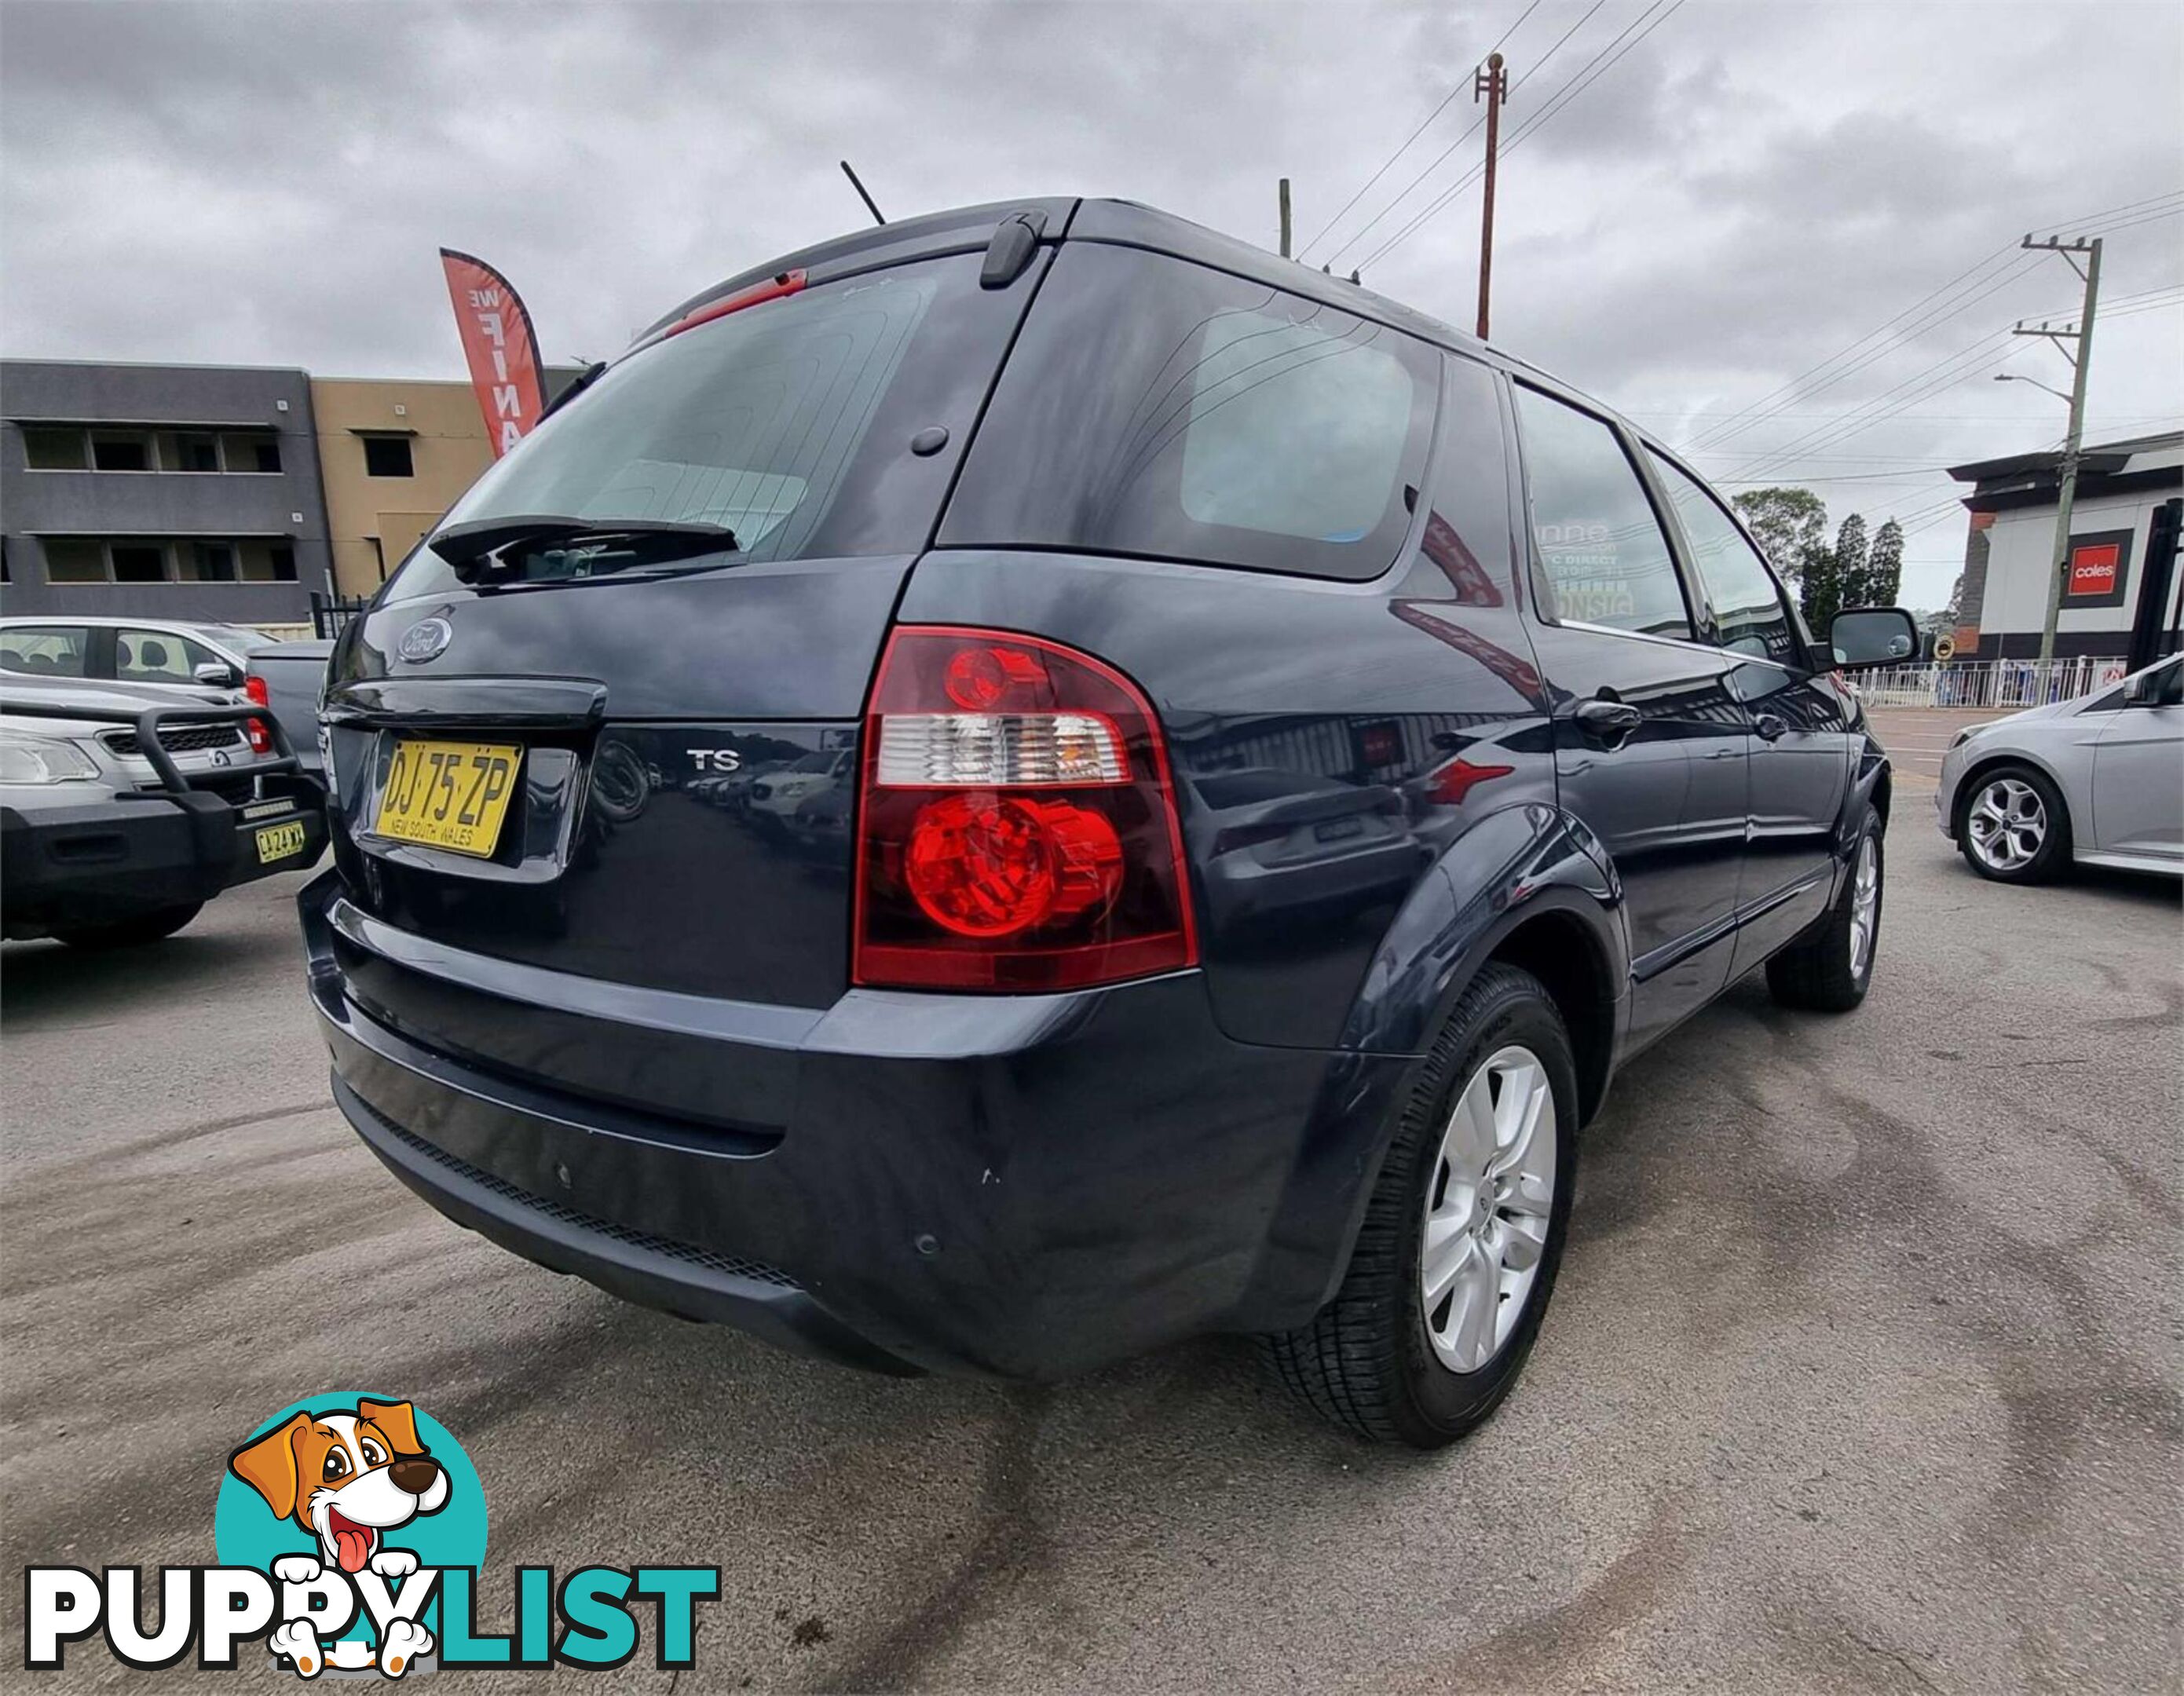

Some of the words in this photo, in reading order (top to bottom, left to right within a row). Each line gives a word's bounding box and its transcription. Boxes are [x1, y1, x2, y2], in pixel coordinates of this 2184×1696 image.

[2076, 564, 2114, 579] coles
[404, 627, 440, 652] Ford
[686, 748, 741, 772] TS
[391, 818, 408, 835] NEW
[409, 821, 437, 840] SOUTH
[440, 826, 474, 846] WALES
